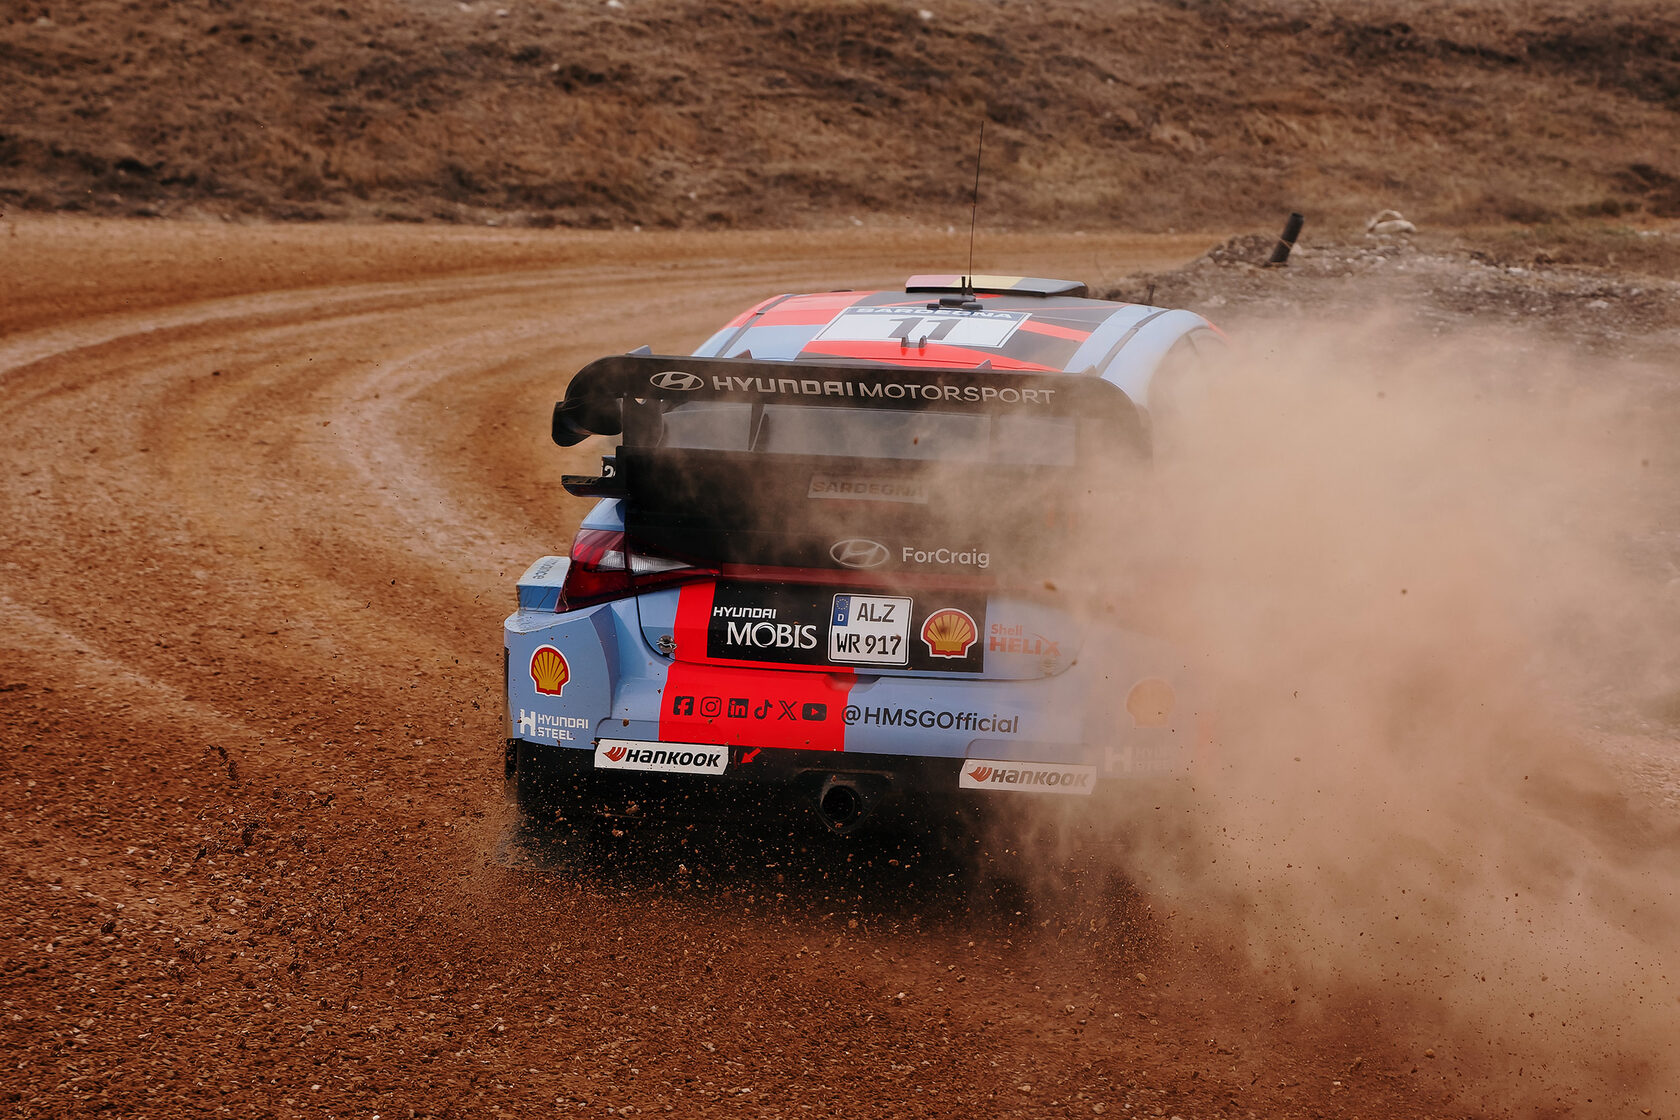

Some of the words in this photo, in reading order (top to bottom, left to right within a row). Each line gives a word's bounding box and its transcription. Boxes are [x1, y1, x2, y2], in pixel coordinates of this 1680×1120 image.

[856, 307, 1014, 319] SARDEGNA
[887, 317, 962, 341] 11
[712, 375, 854, 397] HYUNDAI
[858, 382, 1056, 404] MOTORSPORT
[812, 480, 925, 498] SARDEGNA
[902, 546, 991, 569] ForCraig
[713, 606, 777, 619] HYUNDAI
[837, 613, 845, 622] D
[856, 602, 896, 623] ALZ
[726, 621, 818, 650] MOBIS
[991, 623, 1023, 636] Shell
[836, 632, 861, 654] WR
[864, 634, 902, 656] 917
[989, 634, 1062, 657] HELIX
[537, 713, 589, 729] HYUNDAI
[841, 704, 1019, 734] @HMSGOfficial
[537, 726, 574, 741] STEEL
